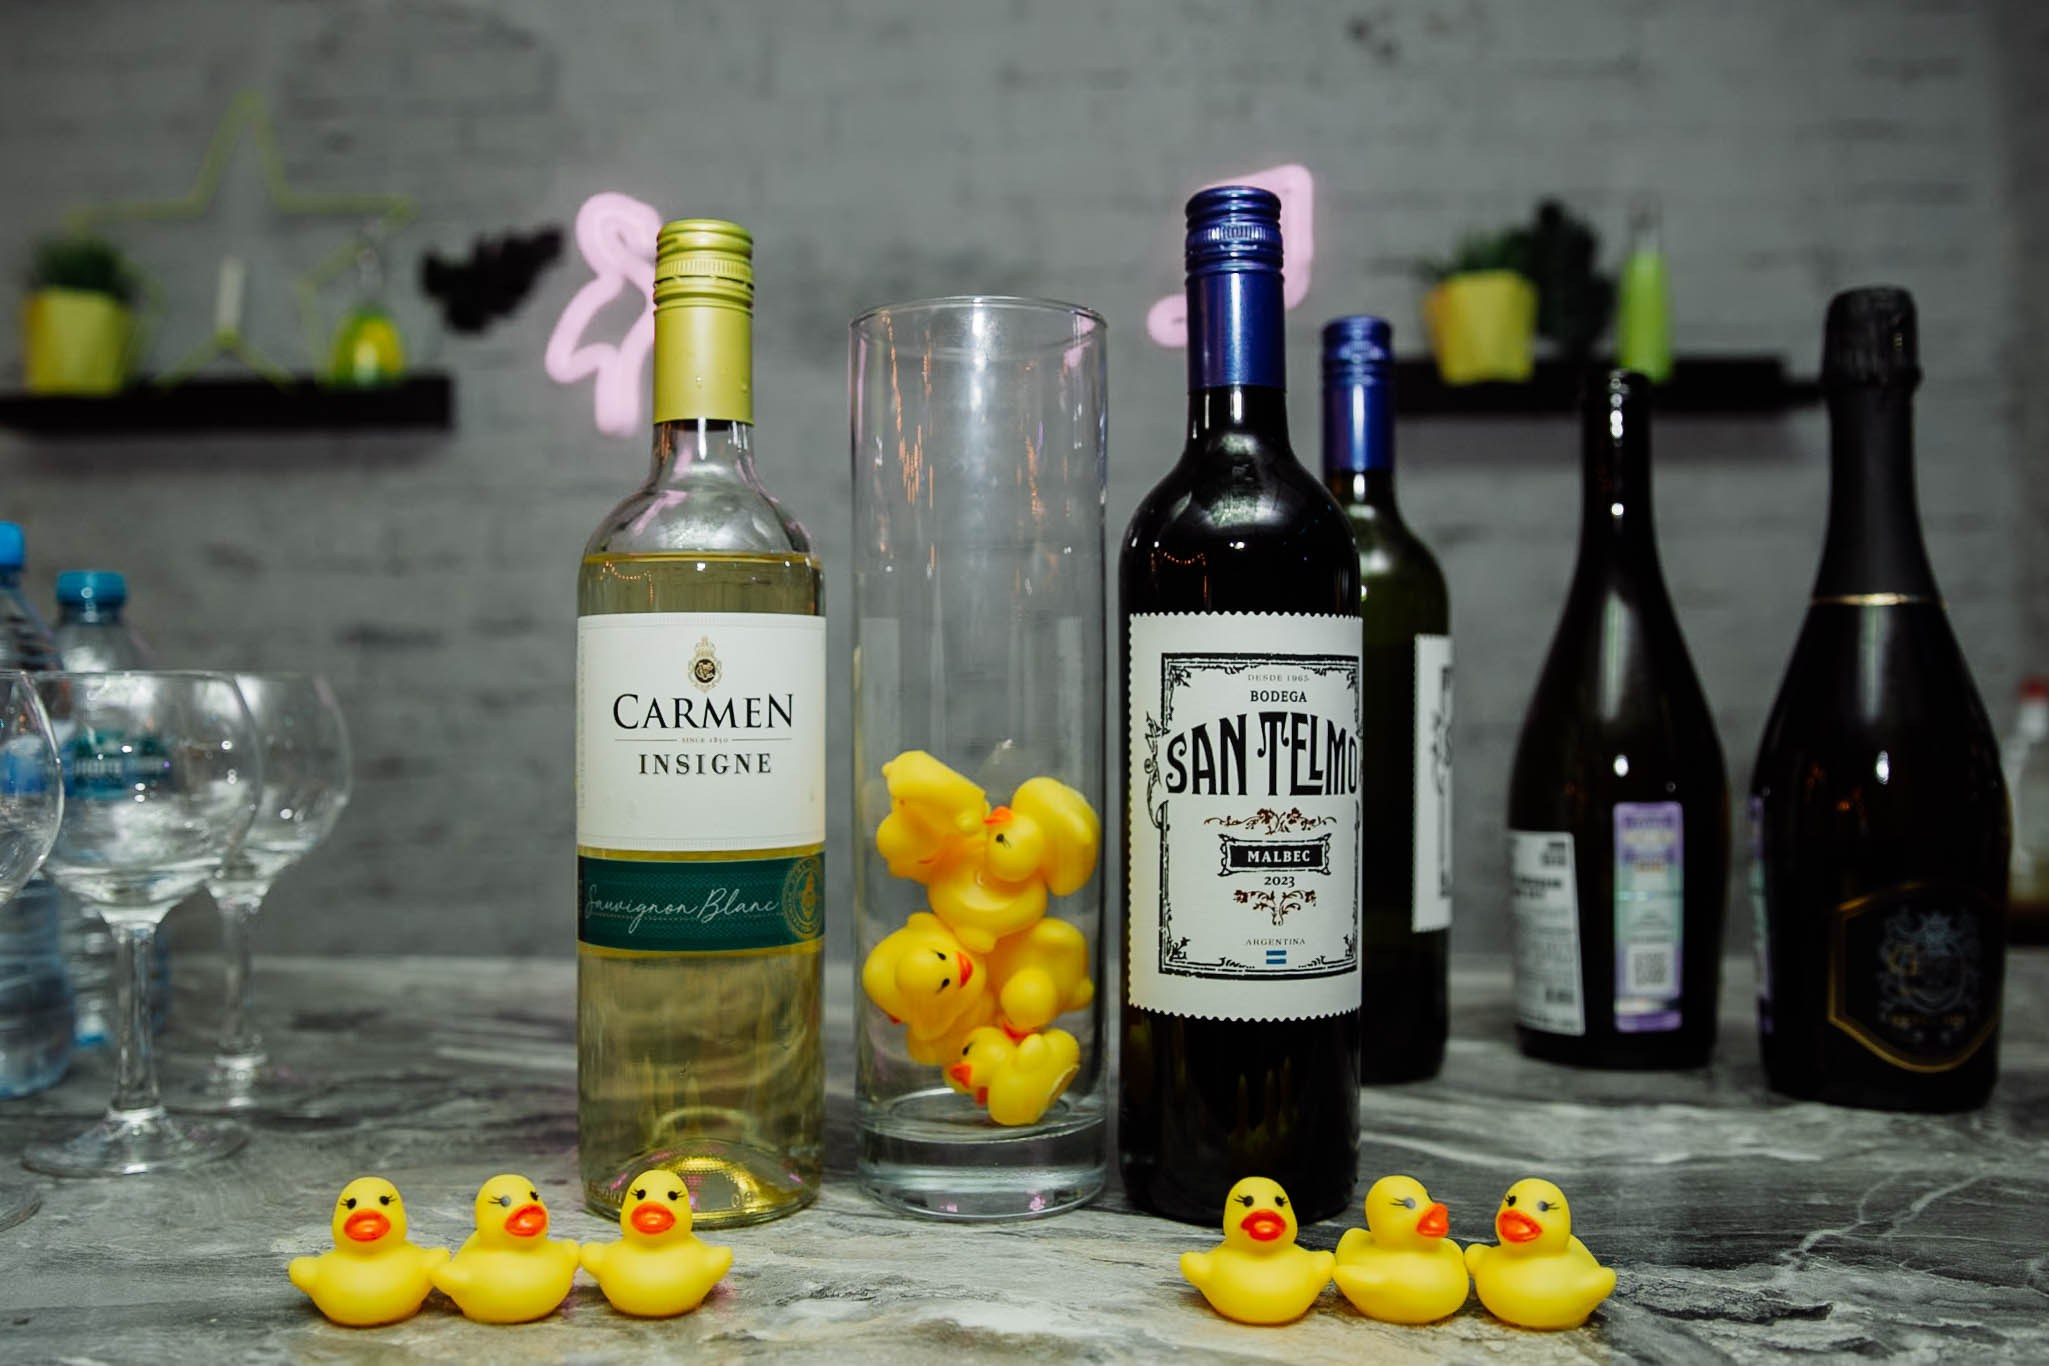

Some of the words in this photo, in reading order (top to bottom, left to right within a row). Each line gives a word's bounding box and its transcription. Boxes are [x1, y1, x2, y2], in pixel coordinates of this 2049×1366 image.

[1247, 674, 1283, 682] DESDE
[1250, 690, 1308, 703] BODEGA
[613, 692, 794, 729] CARMEN
[1166, 713, 1247, 796] SAN
[1257, 711, 1358, 796] TELMO
[639, 753, 772, 775] INSIGNE
[1247, 849, 1311, 863] MALBEC
[1264, 876, 1296, 888] 2023
[585, 884, 699, 934] Sauvignon
[697, 887, 779, 923] Blanc
[1246, 938, 1306, 946] ARGENTINA
